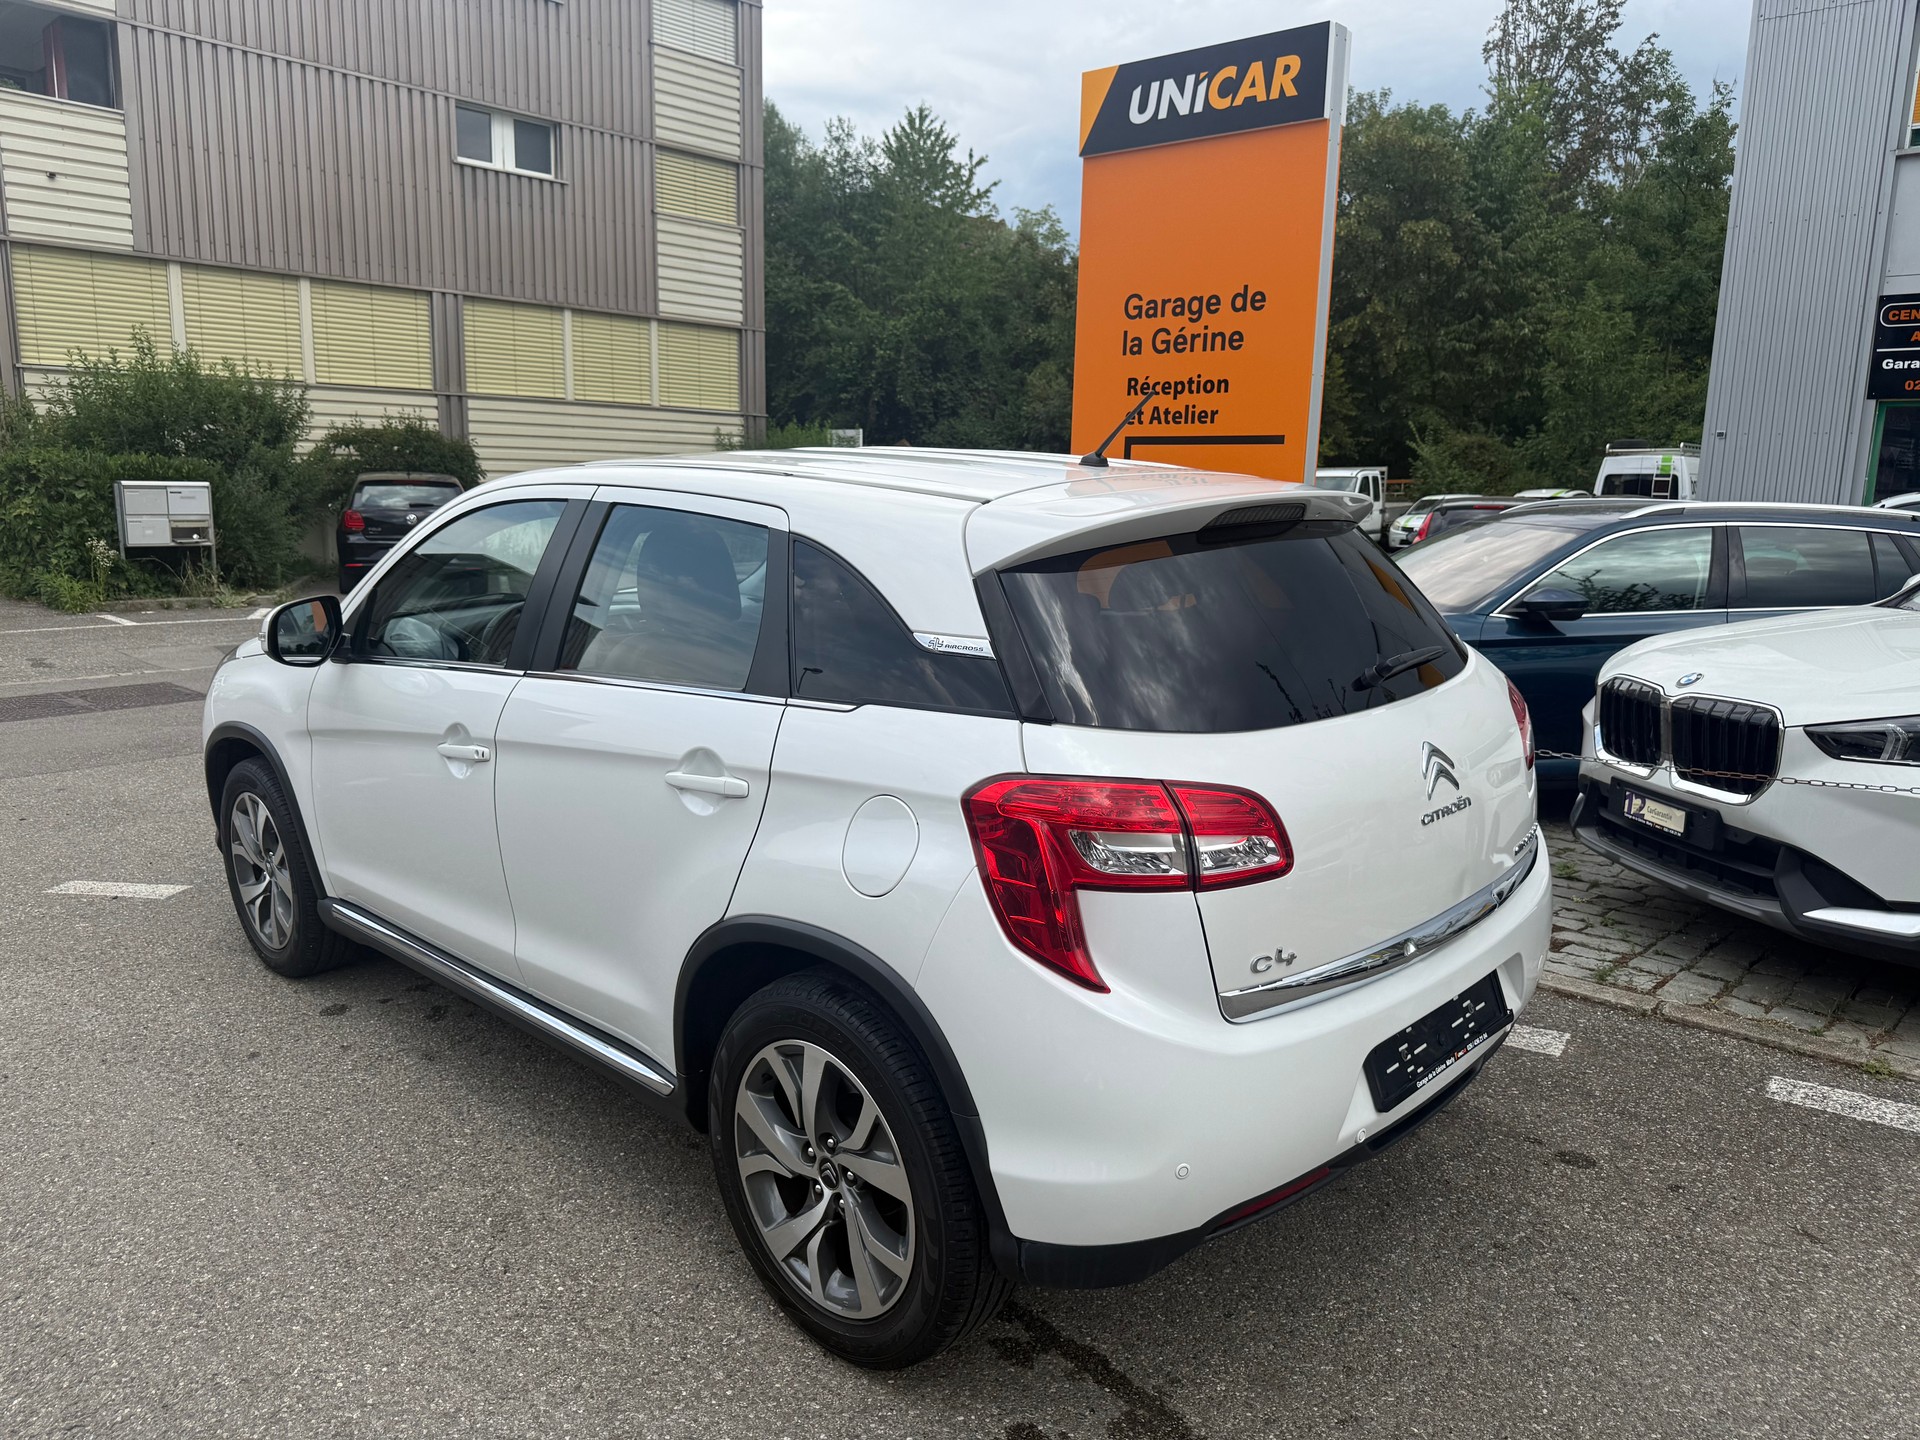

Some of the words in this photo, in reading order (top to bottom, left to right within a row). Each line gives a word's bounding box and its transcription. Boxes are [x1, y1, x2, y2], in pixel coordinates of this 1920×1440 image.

[1124, 293, 1222, 323] Garage
[1231, 284, 1267, 313] de
[1122, 330, 1143, 356] la
[1151, 325, 1244, 354] Gérine
[1126, 374, 1229, 400] Réception
[1149, 404, 1219, 425] Atelier
[944, 643, 983, 652] AIRCROSS
[1420, 795, 1472, 826] CITROËN
[1250, 946, 1297, 973] C4
